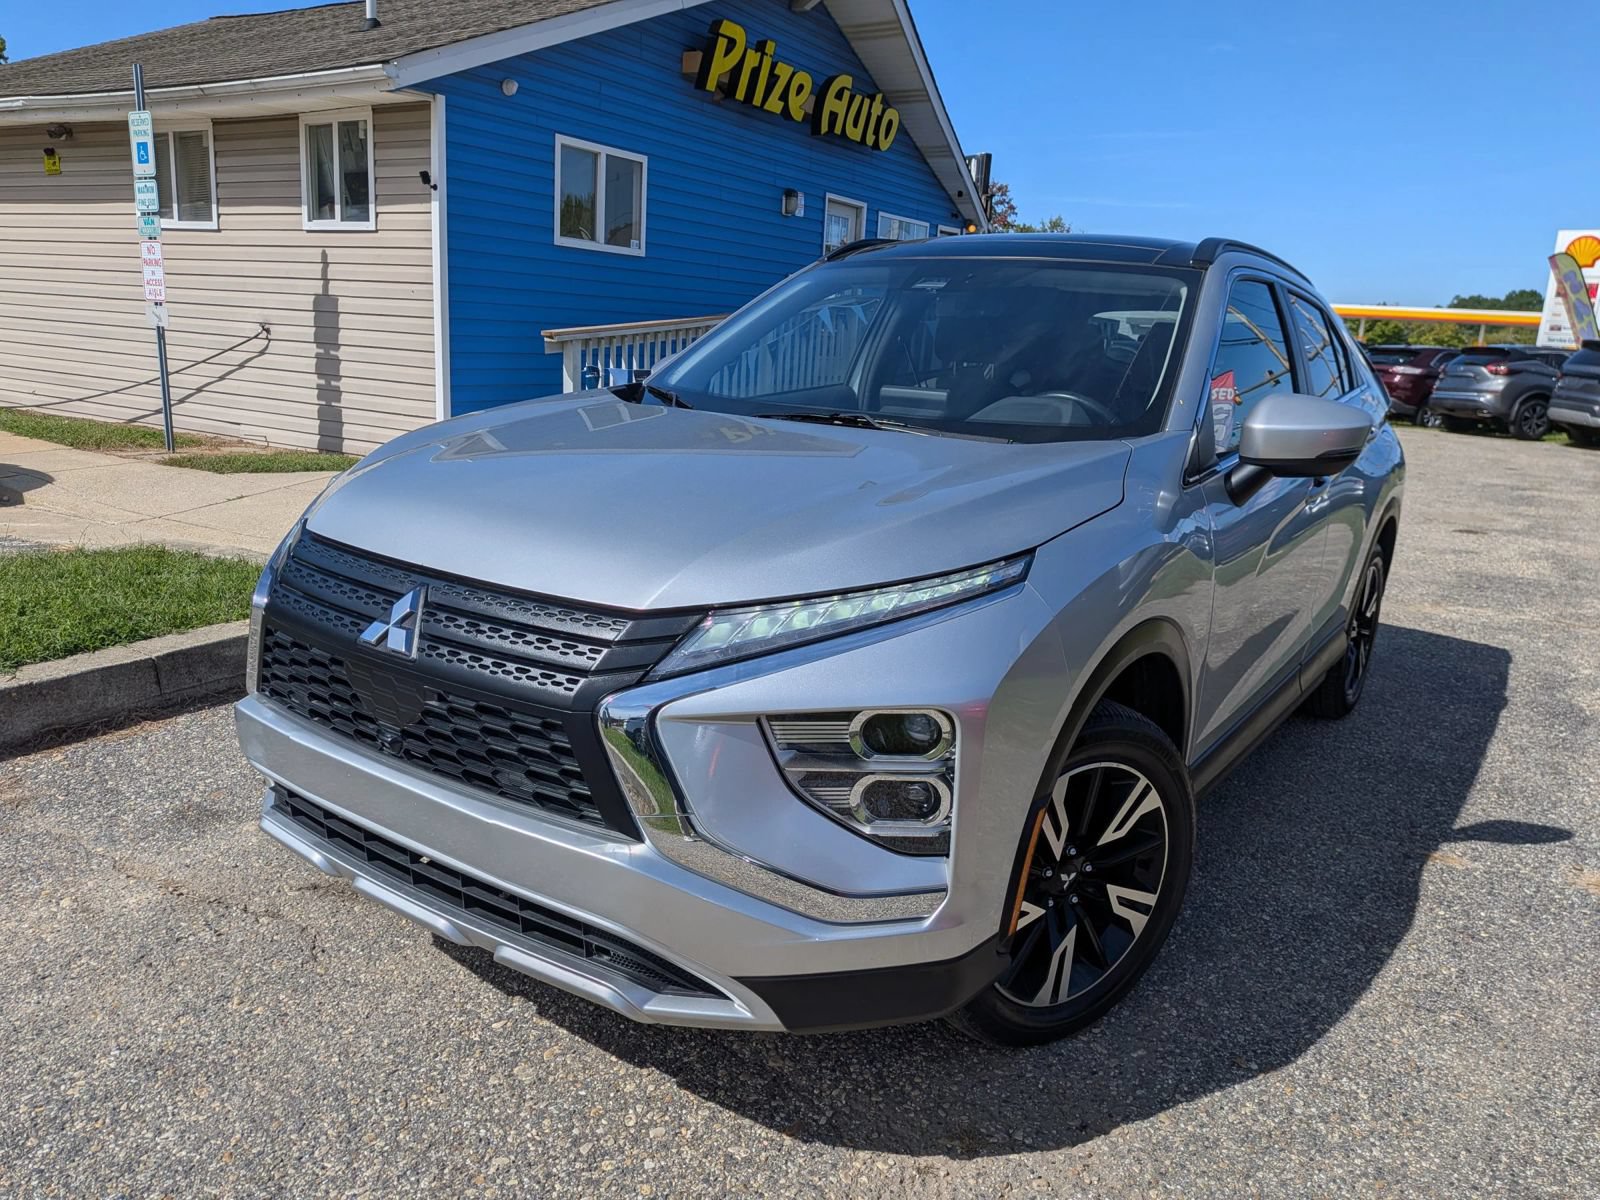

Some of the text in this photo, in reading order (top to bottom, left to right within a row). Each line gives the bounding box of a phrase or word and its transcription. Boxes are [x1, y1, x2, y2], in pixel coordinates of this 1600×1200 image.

[705, 19, 900, 152] Prize Auto
[133, 129, 150, 137] PARKING
[143, 217, 155, 226] VAN
[146, 246, 155, 255] NO
[143, 258, 162, 267] PARKING
[146, 279, 162, 287] ACCESS
[148, 287, 162, 297] AISLE
